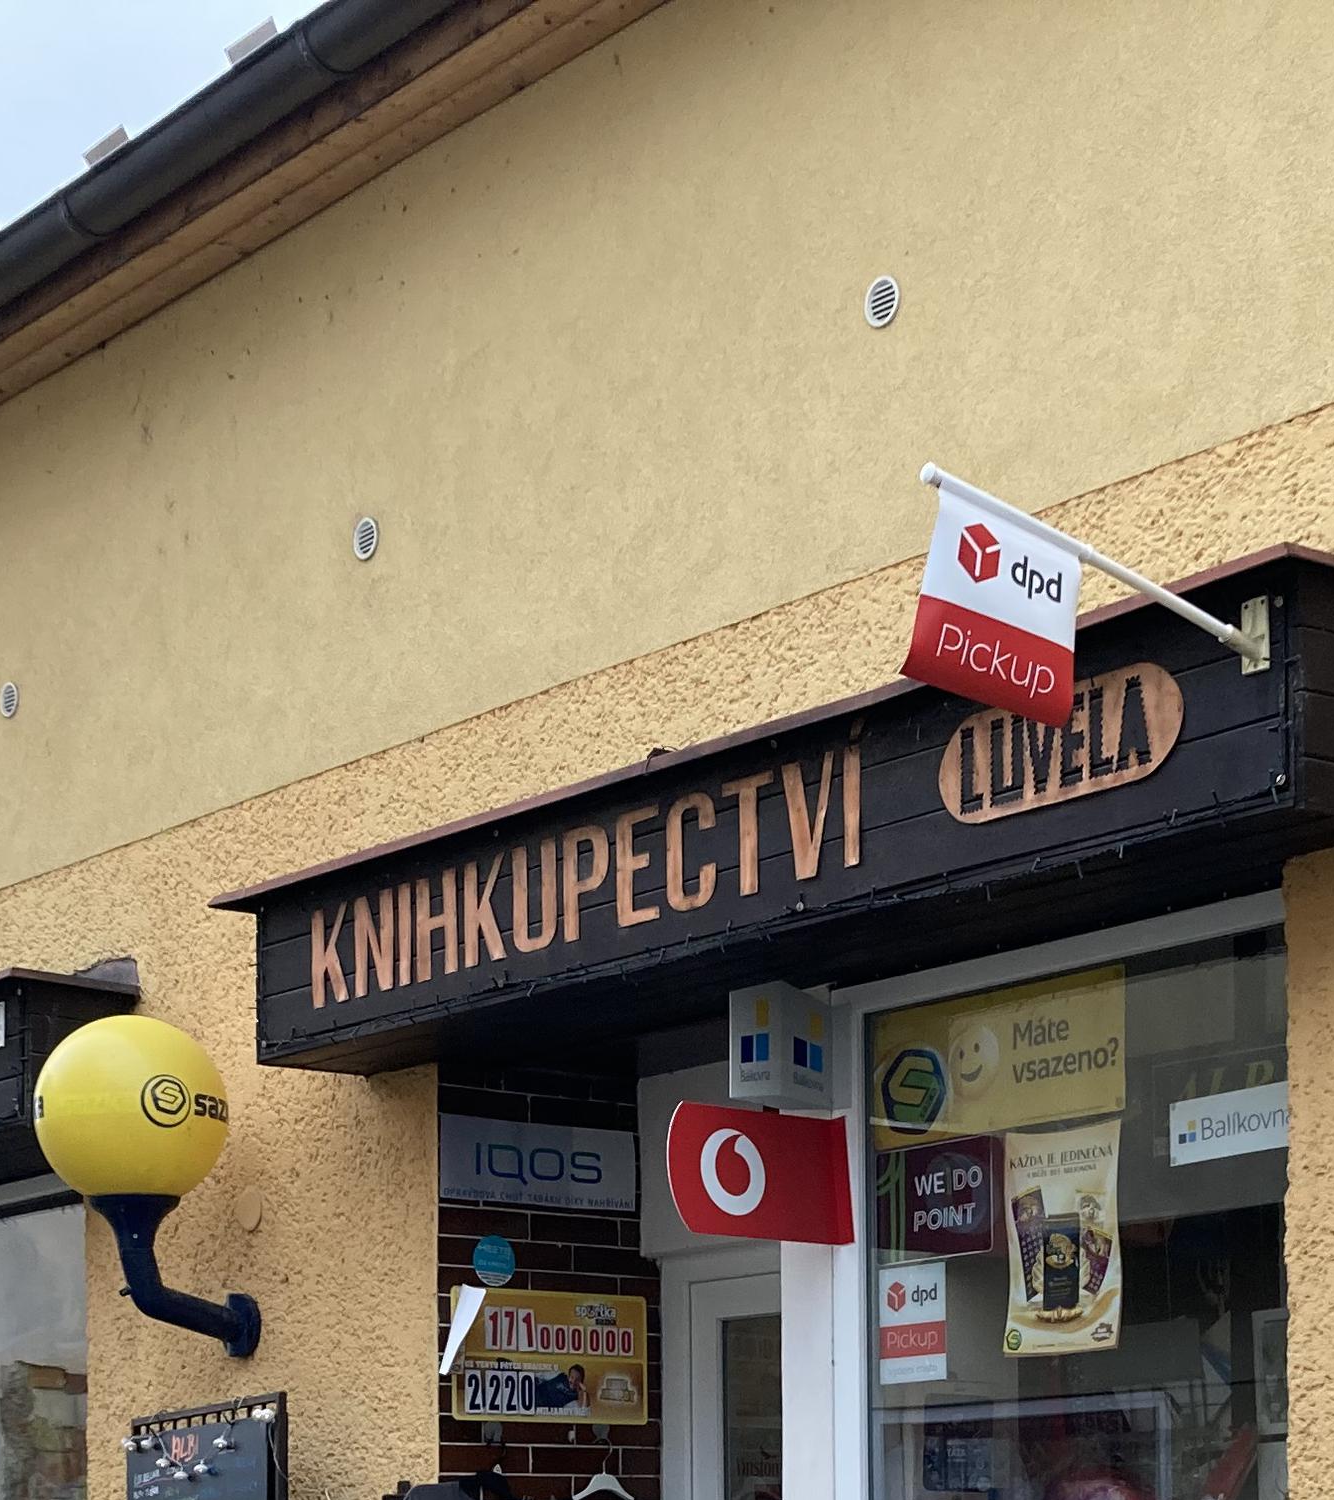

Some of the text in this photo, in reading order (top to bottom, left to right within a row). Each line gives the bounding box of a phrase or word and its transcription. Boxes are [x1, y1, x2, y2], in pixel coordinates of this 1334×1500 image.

[1011, 555, 1063, 604] dpd
[936, 623, 1056, 698] Pickup
[310, 721, 864, 1010] KNIHKUPECTVÍ
[1012, 1016, 1070, 1051] Máte
[1012, 1037, 1120, 1085] vsazeno?
[194, 1093, 228, 1122] saz
[474, 1142, 603, 1186] IQOS
[913, 1203, 976, 1232] POINT
[911, 1282, 938, 1306] dpd
[489, 1311, 534, 1348] 171
[886, 1329, 939, 1349] Pickup
